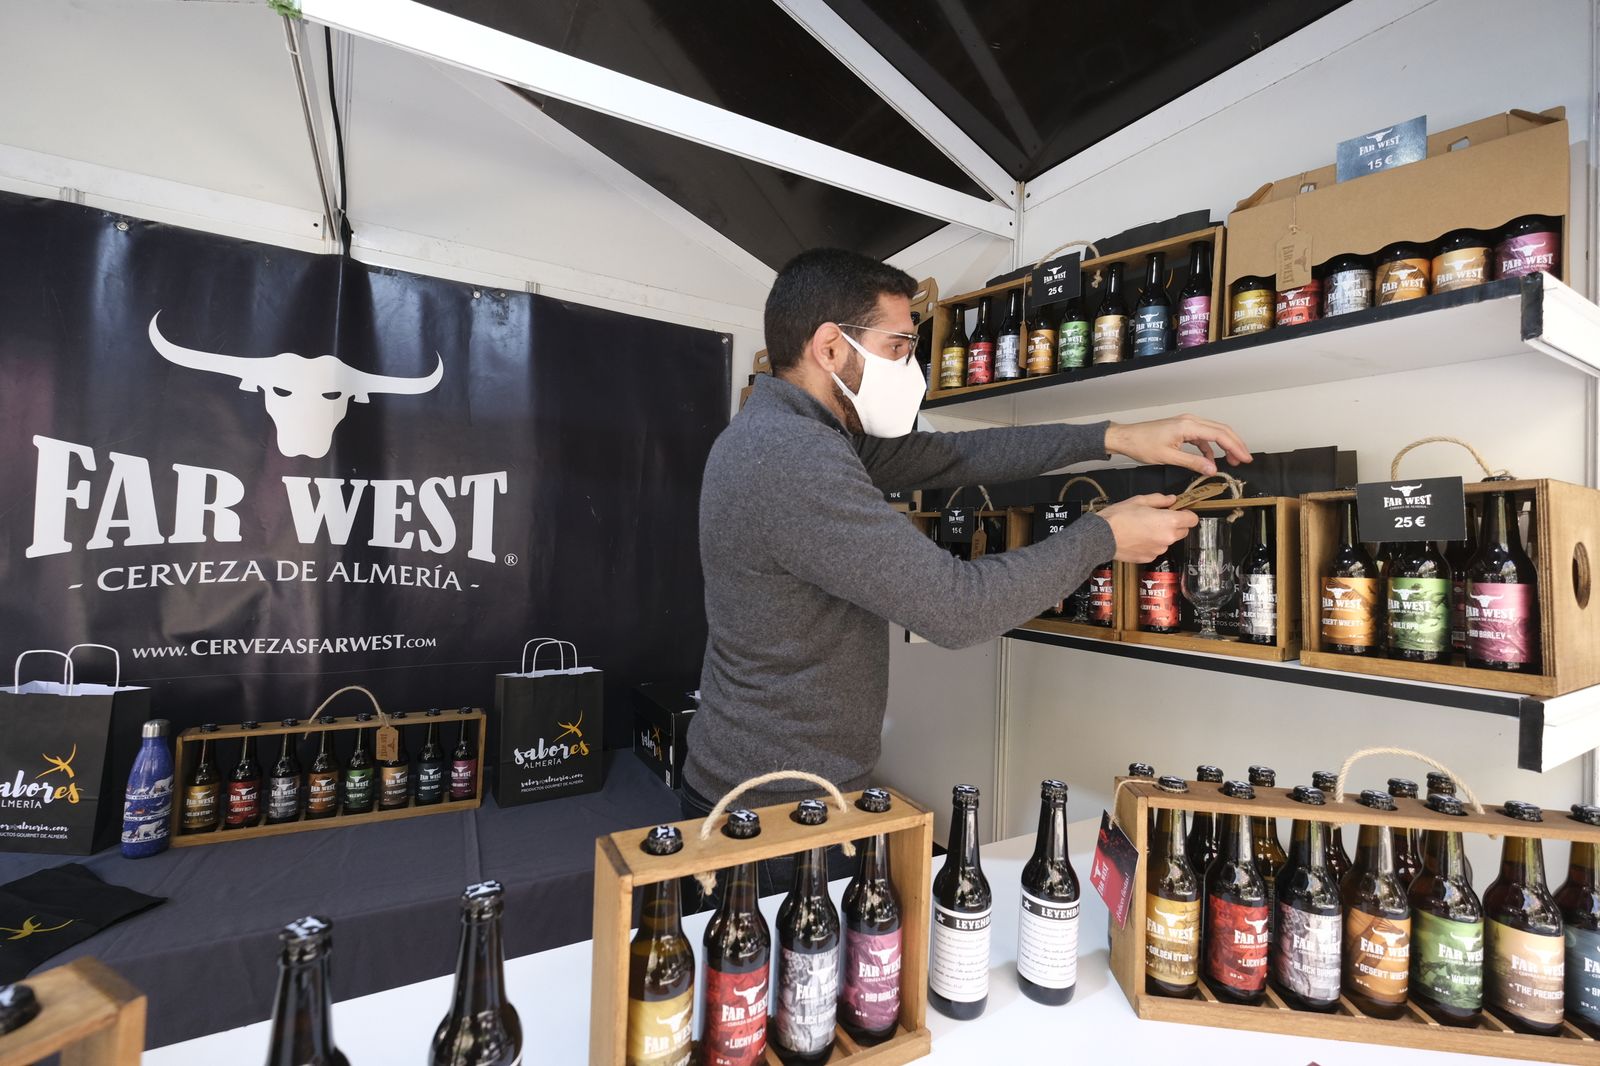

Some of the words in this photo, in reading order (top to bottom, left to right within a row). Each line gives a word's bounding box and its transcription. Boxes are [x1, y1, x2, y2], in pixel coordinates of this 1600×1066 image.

[1359, 143, 1375, 156] FAR
[1377, 134, 1401, 149] WEST
[1367, 158, 1383, 170] 15
[1384, 155, 1393, 165] €
[1502, 260, 1522, 272] FAR
[1526, 253, 1554, 265] WEST
[1054, 271, 1067, 280] WEST
[1437, 274, 1452, 286] FAR
[1456, 267, 1483, 279] WEST
[1047, 286, 1057, 296] 25
[1058, 285, 1064, 293] €
[1382, 283, 1398, 293] FAR
[1400, 278, 1424, 289] WEST
[1276, 302, 1286, 313] FAR
[1288, 297, 1310, 307] WEST
[1191, 312, 1210, 320] WEST
[1147, 321, 1164, 330] WEST
[26, 434, 245, 558] FAR
[281, 470, 507, 563] WEST
[1383, 497, 1403, 508] FAR
[1405, 494, 1432, 506] WEST
[1055, 511, 1068, 519] WEST
[1394, 516, 1413, 528] 25
[1415, 516, 1426, 528] €
[1050, 525, 1059, 533] 20
[97, 561, 266, 591] CERVEZA
[276, 560, 318, 582] DE
[327, 561, 462, 591] ALMERÍA
[1148, 588, 1166, 597] WEST
[1336, 599, 1361, 608] WEST
[1402, 600, 1432, 611] WEST
[1482, 608, 1516, 621] WEST
[514, 738, 590, 765] sabores
[523, 758, 562, 769] ALMERÍA
[0, 770, 81, 804] abores
[1, 799, 42, 809] LMERÍA
[1147, 917, 1165, 935] FAR
[1168, 926, 1194, 940] WEST
[1234, 929, 1255, 945] FAR
[1293, 933, 1314, 951] FAR
[1149, 945, 1172, 960] GOLDEN
[1361, 937, 1384, 956] FAR
[1438, 943, 1462, 960] FAR
[859, 961, 880, 978] FAR
[1242, 958, 1260, 967] LUCKY
[1512, 954, 1537, 971] FAR
[1584, 957, 1600, 974] FA
[1360, 963, 1388, 979] DESERT
[1515, 983, 1533, 997] THE
[721, 1004, 745, 1022] FAR
[644, 1035, 669, 1054] FAR
[729, 1035, 753, 1049] LUCKY
